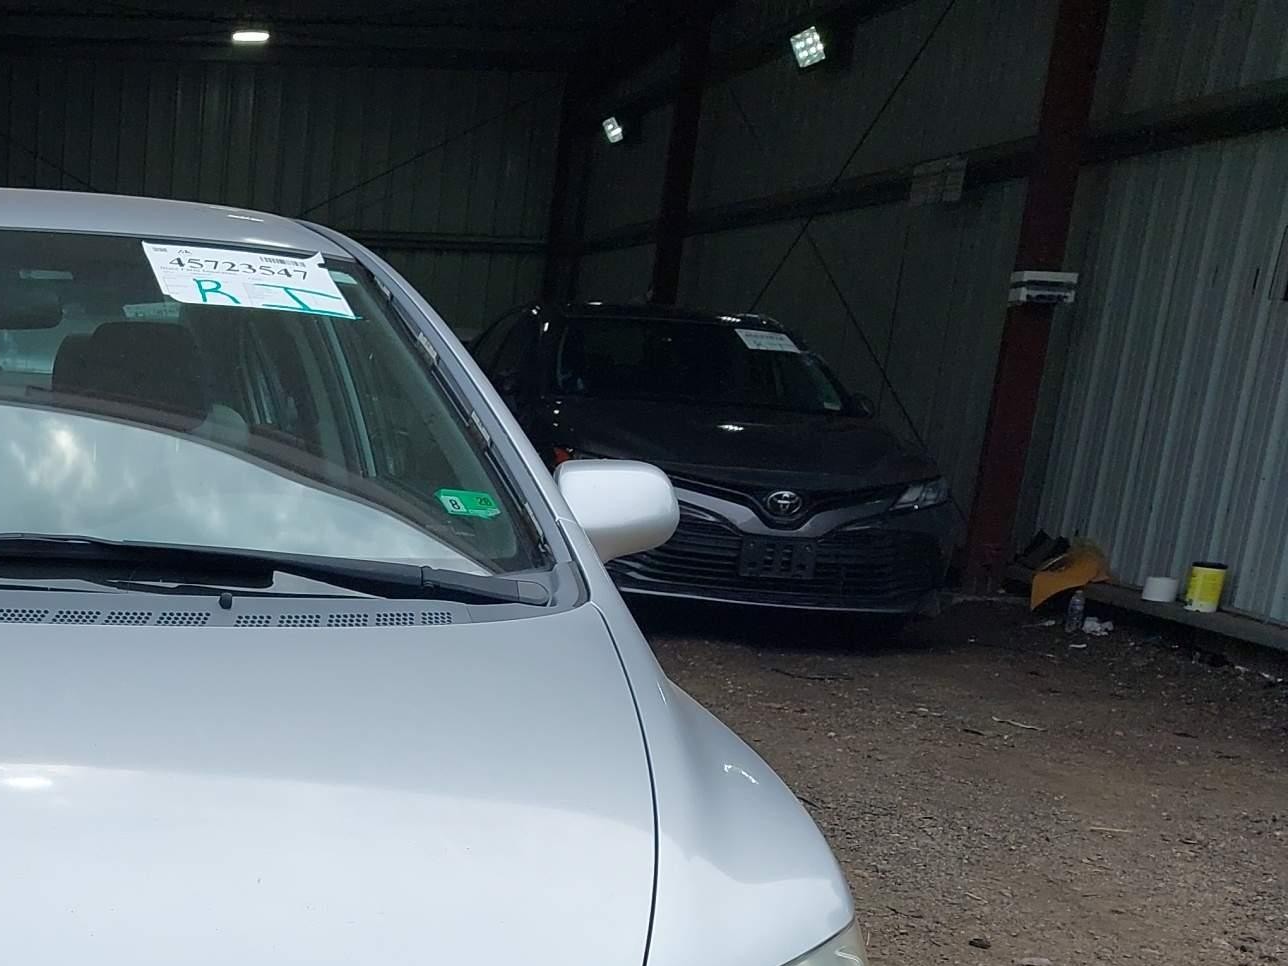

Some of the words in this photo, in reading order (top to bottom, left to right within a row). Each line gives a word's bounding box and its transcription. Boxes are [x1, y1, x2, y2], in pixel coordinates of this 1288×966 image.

[169, 256, 308, 281] 45723547
[192, 278, 241, 305] R
[449, 499, 461, 510] 8
